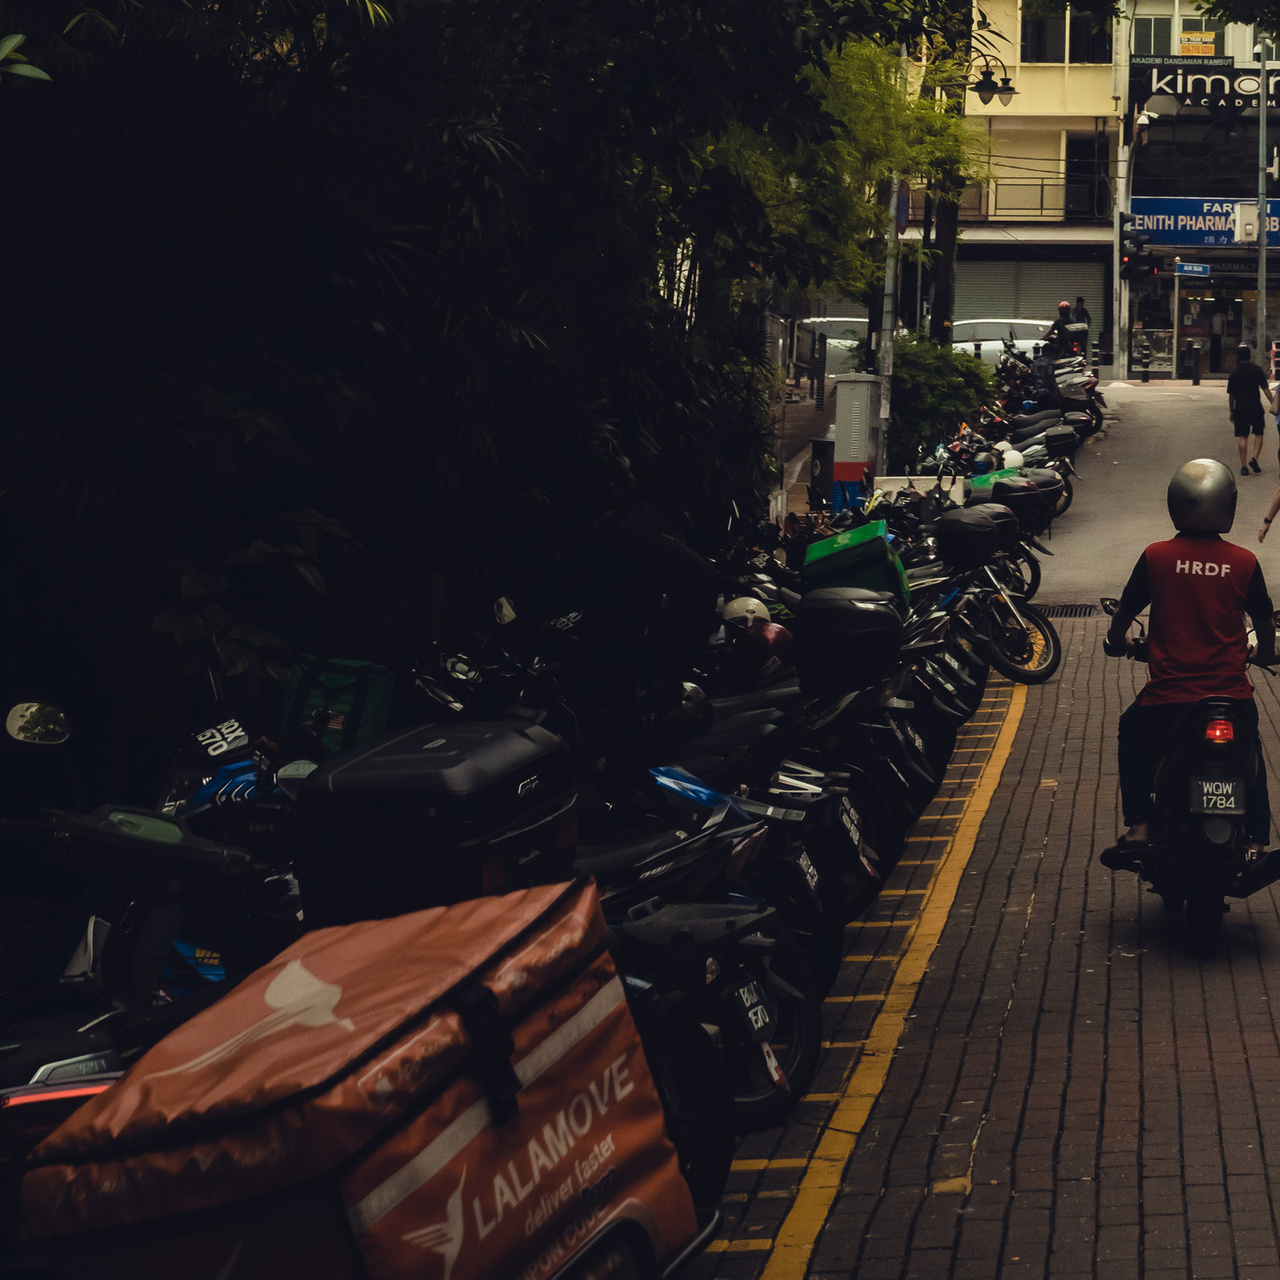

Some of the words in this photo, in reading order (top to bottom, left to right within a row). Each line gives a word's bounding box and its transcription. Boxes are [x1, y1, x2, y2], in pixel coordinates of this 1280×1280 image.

[1131, 57, 1163, 65] AKADEMI
[1163, 57, 1203, 66] DANDANAN
[1203, 58, 1233, 66] RAMBUT
[1175, 559, 1231, 578] HRDF
[1202, 781, 1233, 795] WQW
[1202, 795, 1236, 809] 1784
[473, 1052, 635, 1241] LALAMOVE
[525, 1176, 575, 1237] deliver
[574, 1133, 616, 1189] faster
